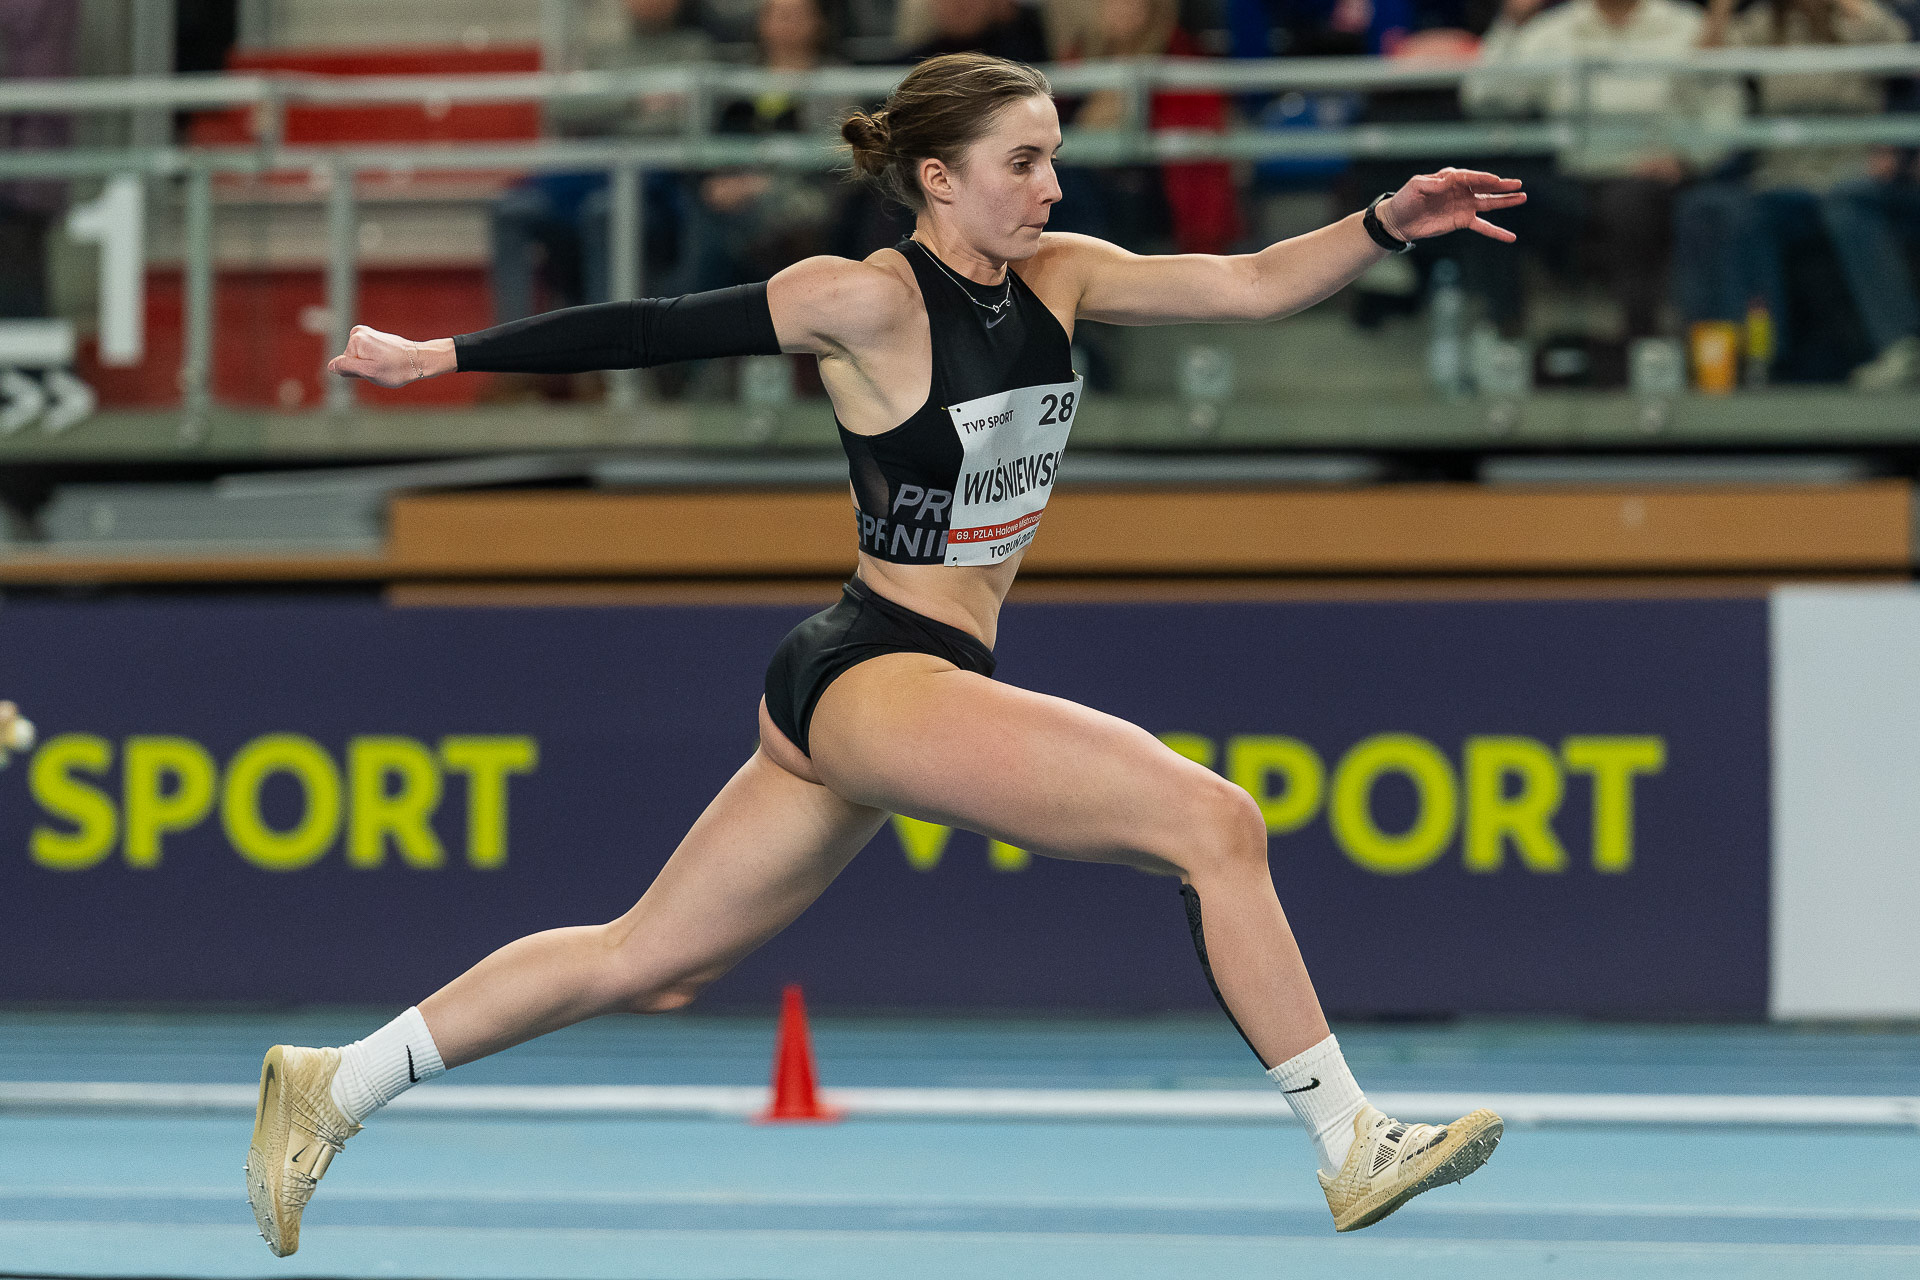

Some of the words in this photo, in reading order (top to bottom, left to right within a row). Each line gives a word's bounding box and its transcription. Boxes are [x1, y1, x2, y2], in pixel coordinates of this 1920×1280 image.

[962, 419, 986, 434] TVP
[987, 410, 1014, 429] SPORT
[1038, 391, 1074, 426] 28
[892, 483, 953, 523] PR
[956, 531, 971, 541] 69.
[973, 528, 994, 539] PZLA
[995, 523, 1019, 537] Halowe
[29, 734, 537, 870] SPORT
[1155, 734, 1664, 871] PORT
